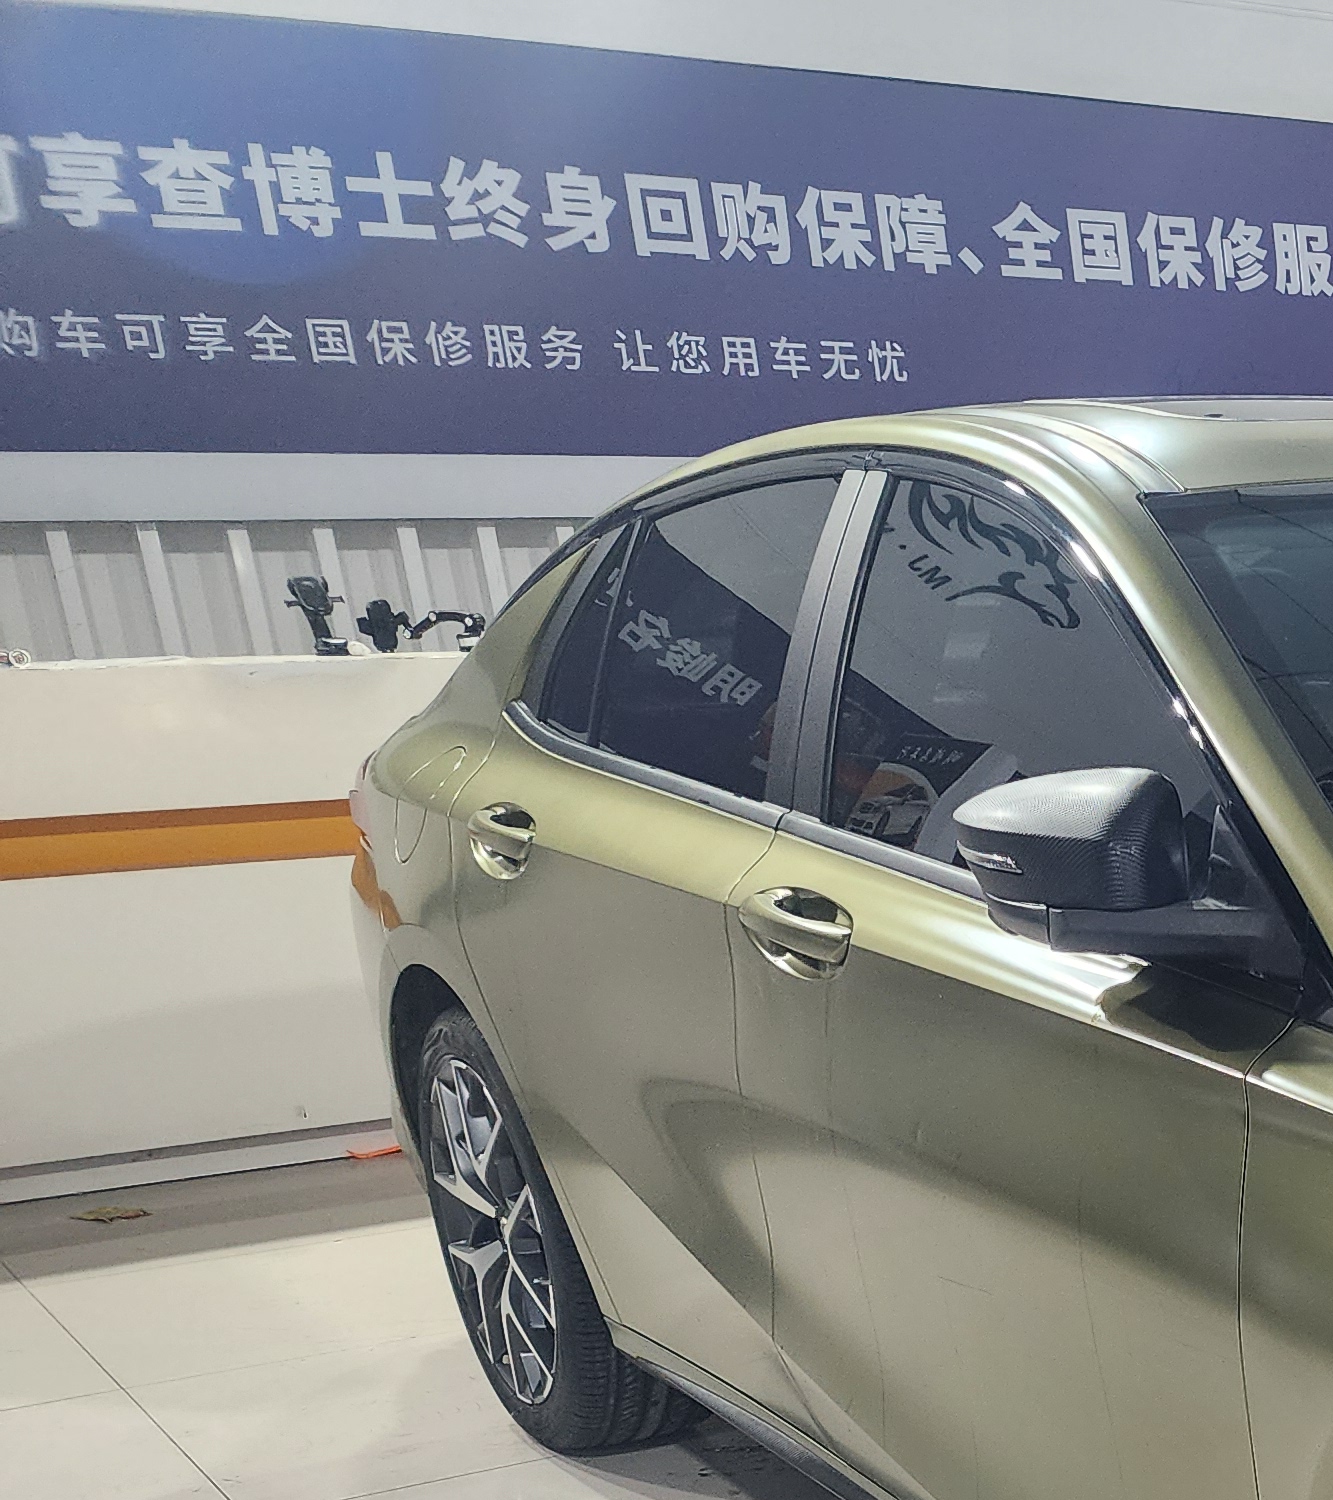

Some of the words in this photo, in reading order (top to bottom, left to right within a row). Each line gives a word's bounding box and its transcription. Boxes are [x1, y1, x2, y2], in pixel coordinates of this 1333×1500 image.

[613, 329, 908, 382] 让您用车无忧
